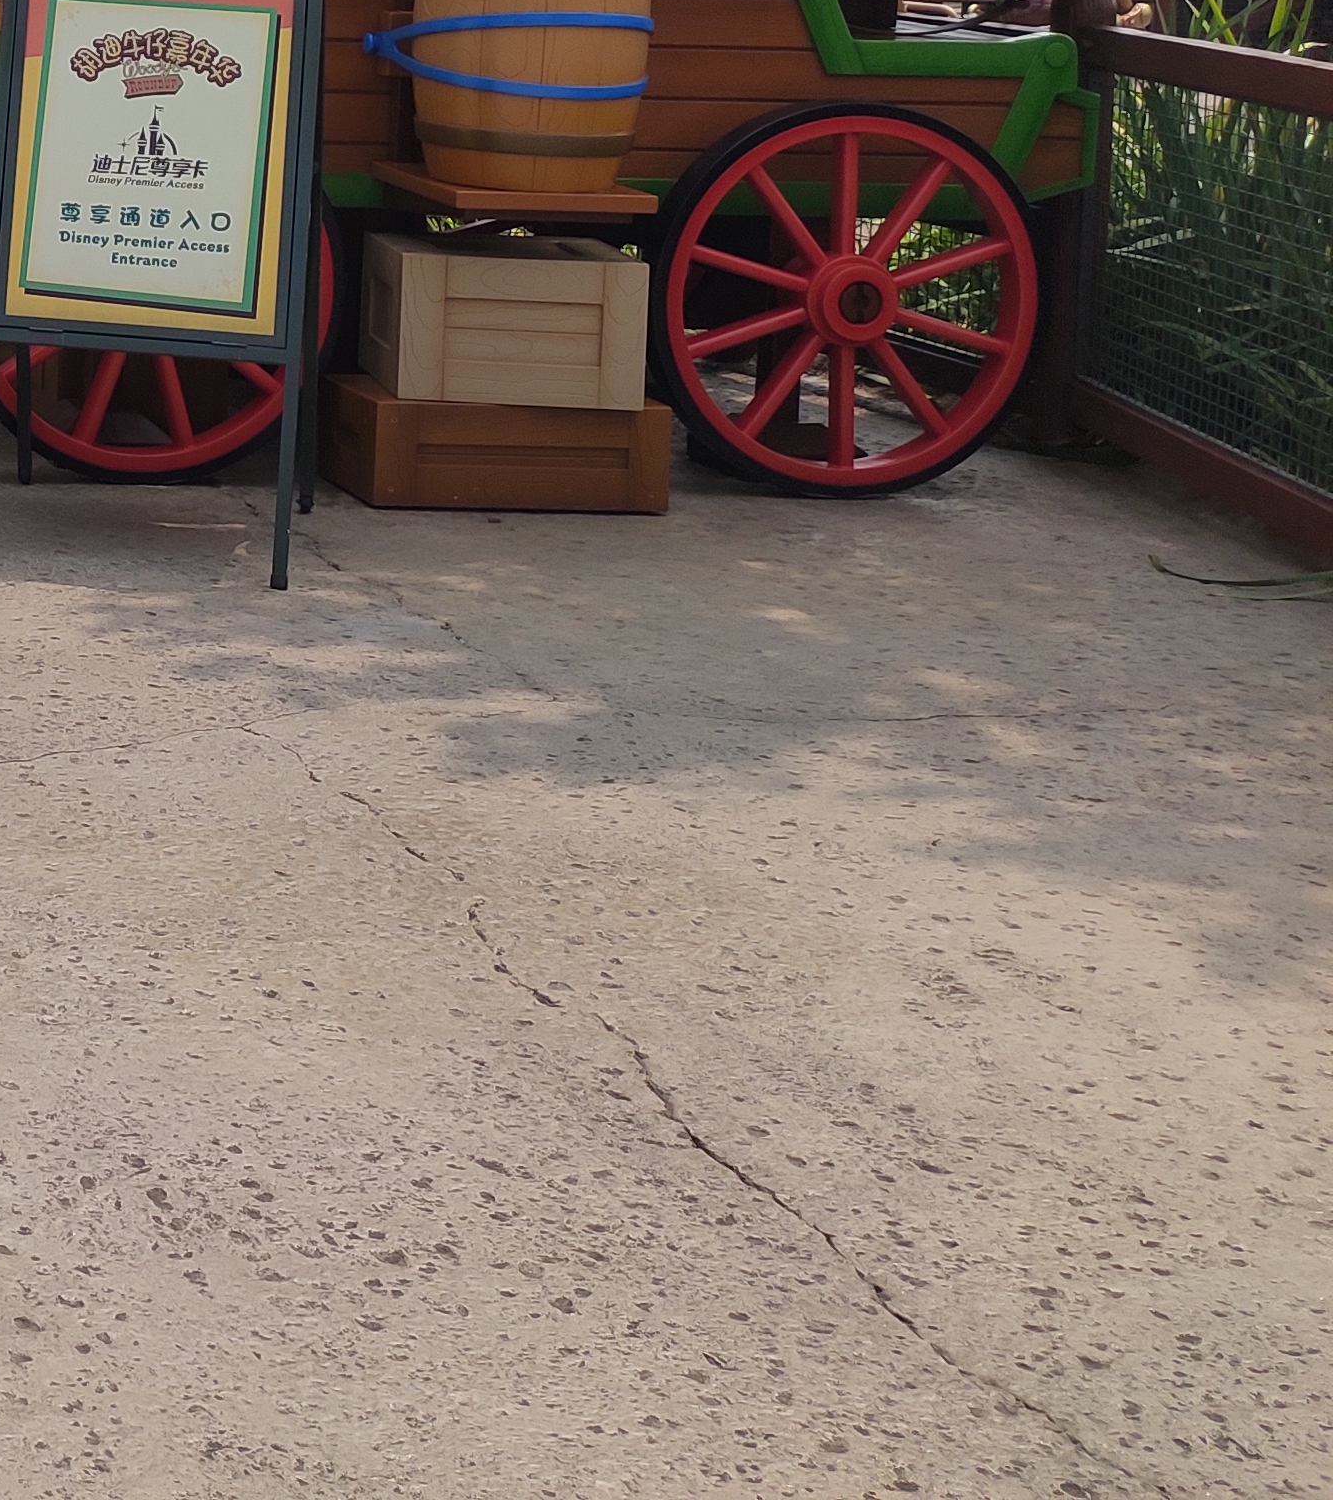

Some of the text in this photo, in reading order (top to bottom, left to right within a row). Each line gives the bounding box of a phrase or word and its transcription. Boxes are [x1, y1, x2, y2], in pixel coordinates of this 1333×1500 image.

[71, 29, 241, 86] 胡迪牛仔嘉年华
[129, 79, 177, 92] ROUNDUP
[90, 154, 208, 179] 迪士尼尊享卡
[87, 175, 204, 190] Disney Premier Access
[60, 202, 231, 231] 尊享通道入口
[59, 231, 230, 253] Disney Premier Access
[111, 252, 177, 268] Entrance
